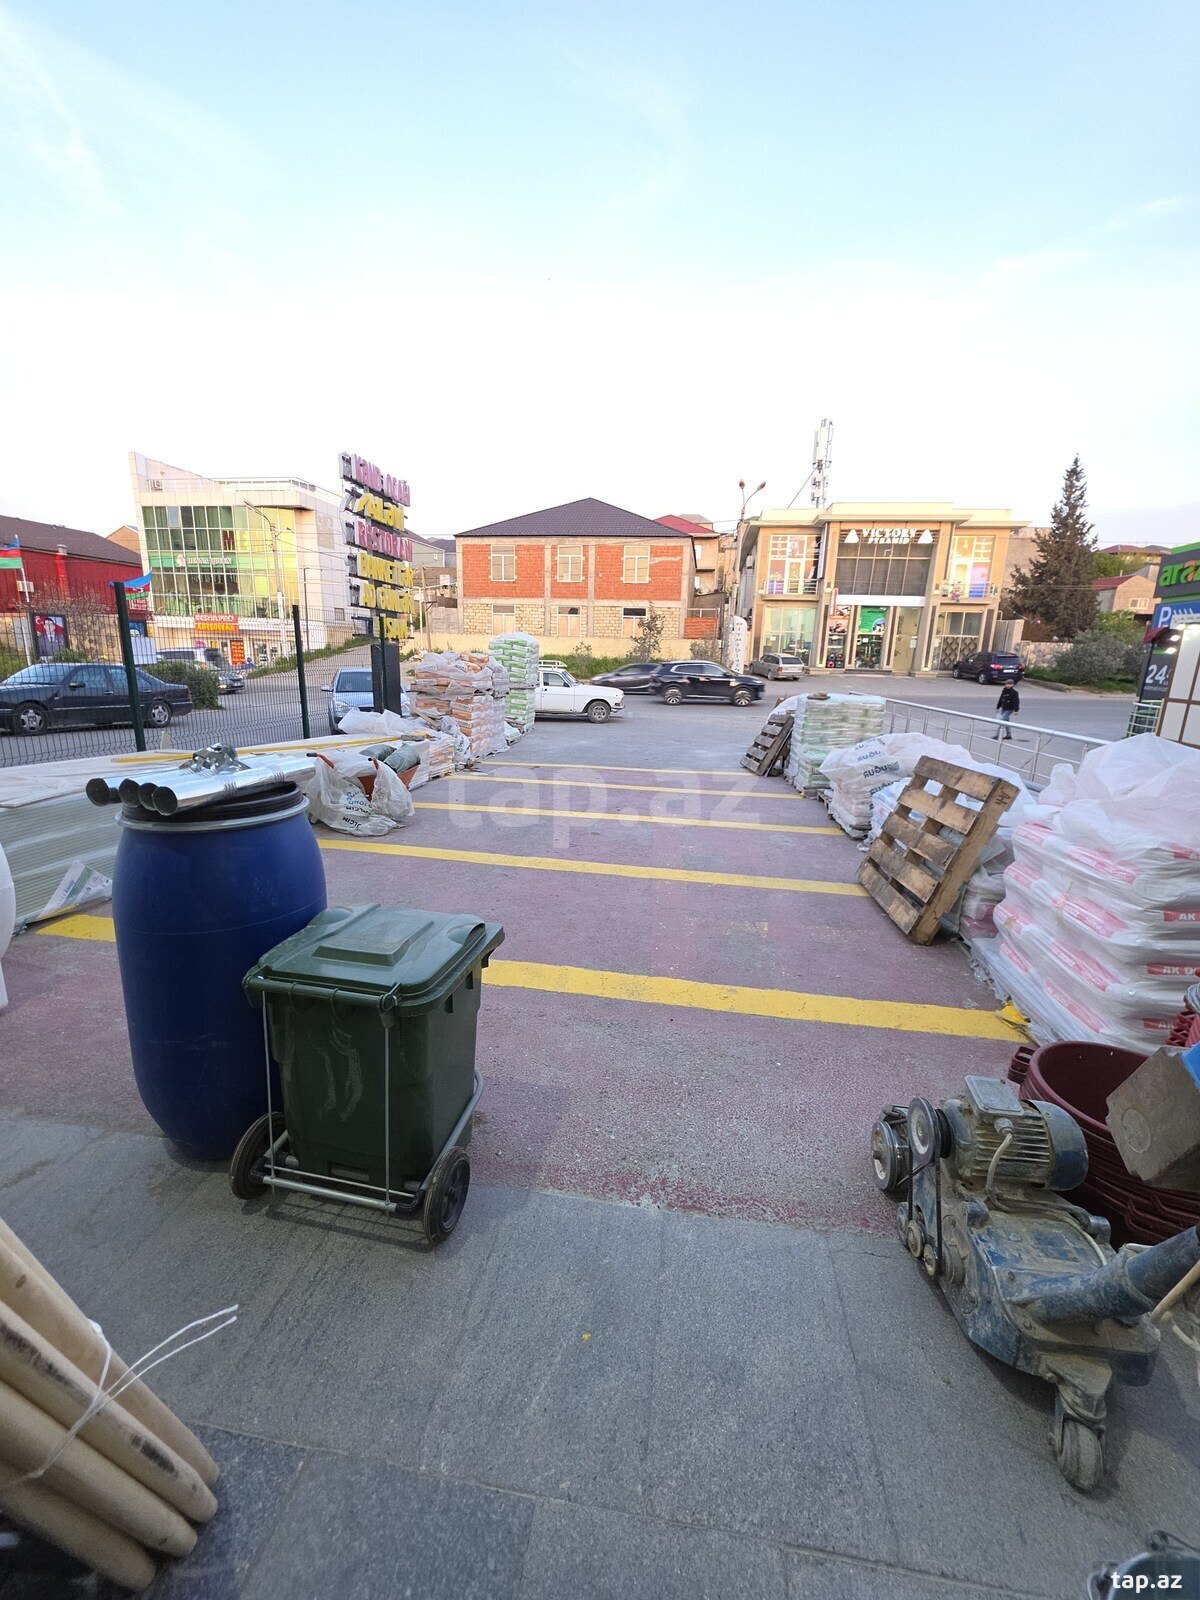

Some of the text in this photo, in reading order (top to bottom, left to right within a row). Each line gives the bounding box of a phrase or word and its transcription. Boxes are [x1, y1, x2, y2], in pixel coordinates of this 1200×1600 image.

[862, 527, 918, 538] VICTORY
[356, 520, 412, 562] RESTORAN
[868, 537, 910, 545] PYRAMID
[1179, 912, 1196, 921] AK
